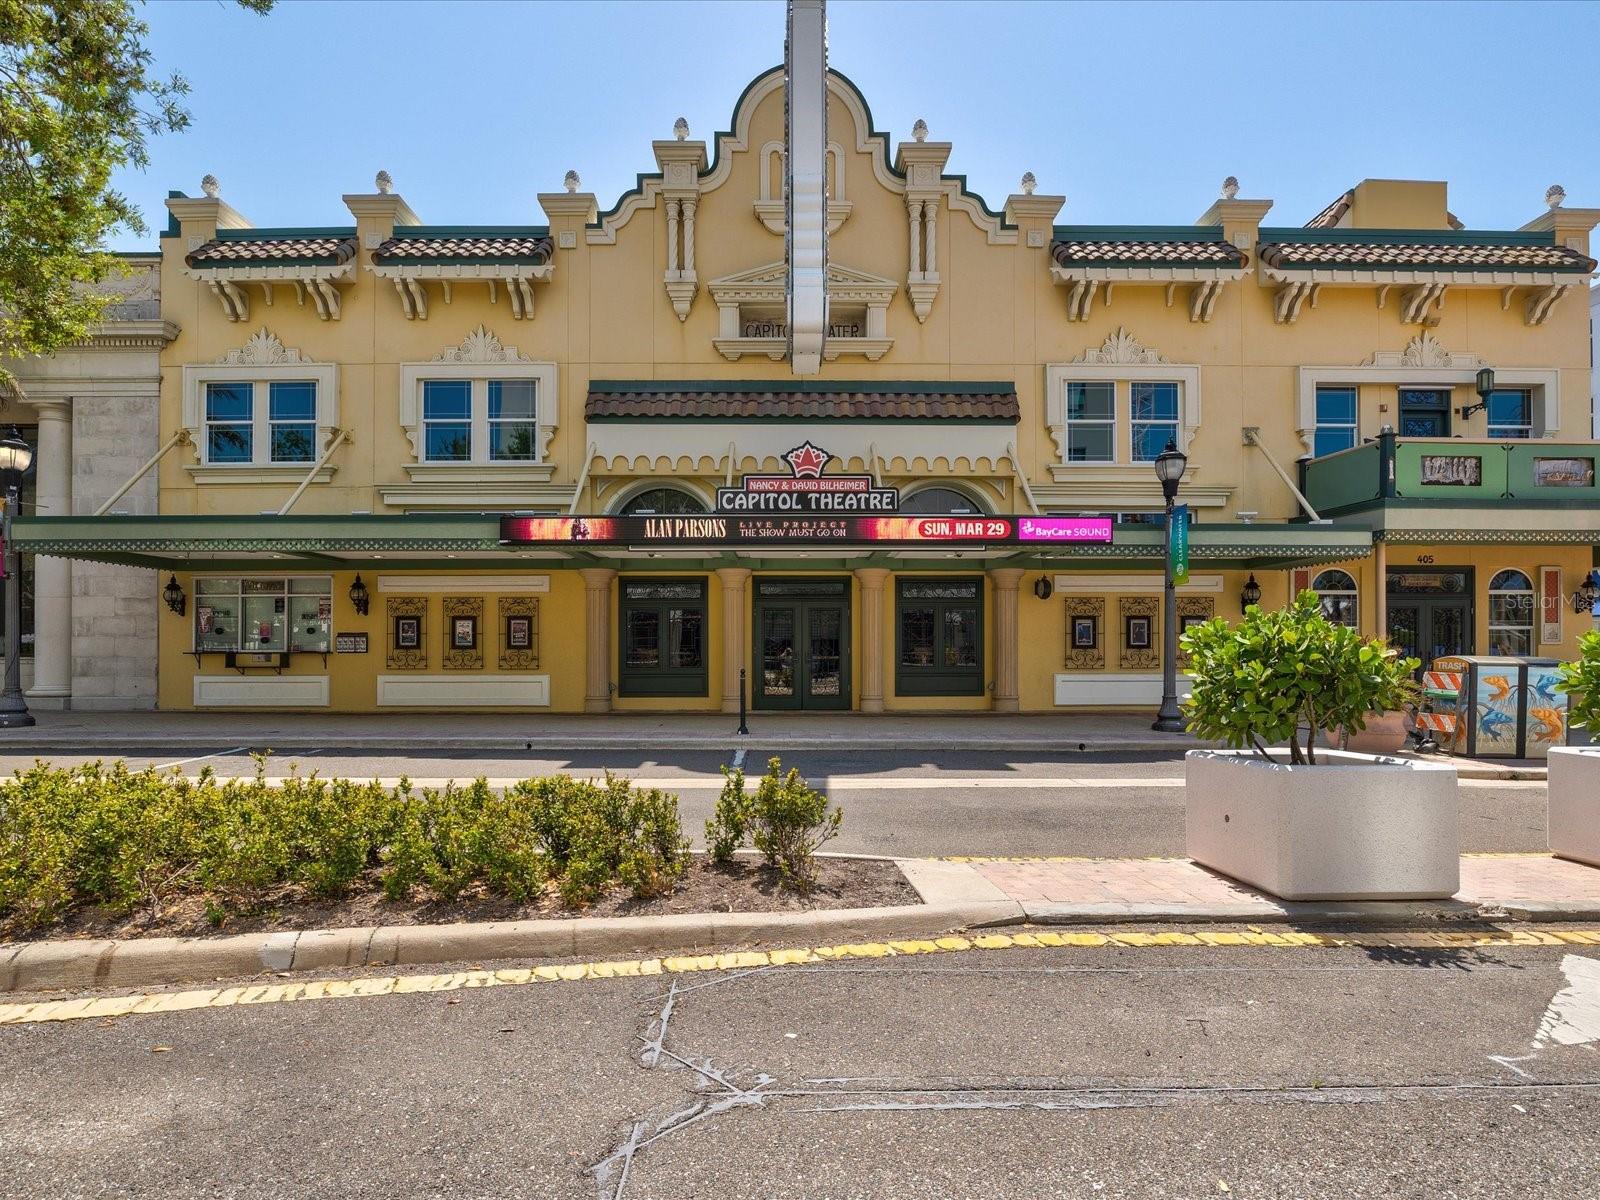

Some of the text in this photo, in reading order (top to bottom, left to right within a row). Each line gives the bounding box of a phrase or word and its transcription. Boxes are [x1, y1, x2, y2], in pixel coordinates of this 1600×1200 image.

[745, 324, 860, 338] CAPIT ATER
[750, 481, 866, 490] NANCY & DAVID BILHEIMER
[722, 493, 894, 510] CAPITOL THEATRE
[644, 519, 727, 538] ALAN PARSONS
[739, 521, 847, 529] LIVE PROJECT
[956, 522, 983, 536] MAR
[987, 522, 1005, 536] 29
[740, 528, 846, 537] THE SHOW MUST GO ON
[1035, 527, 1109, 538] BayCare SOUND
[1417, 555, 1434, 564] 405
